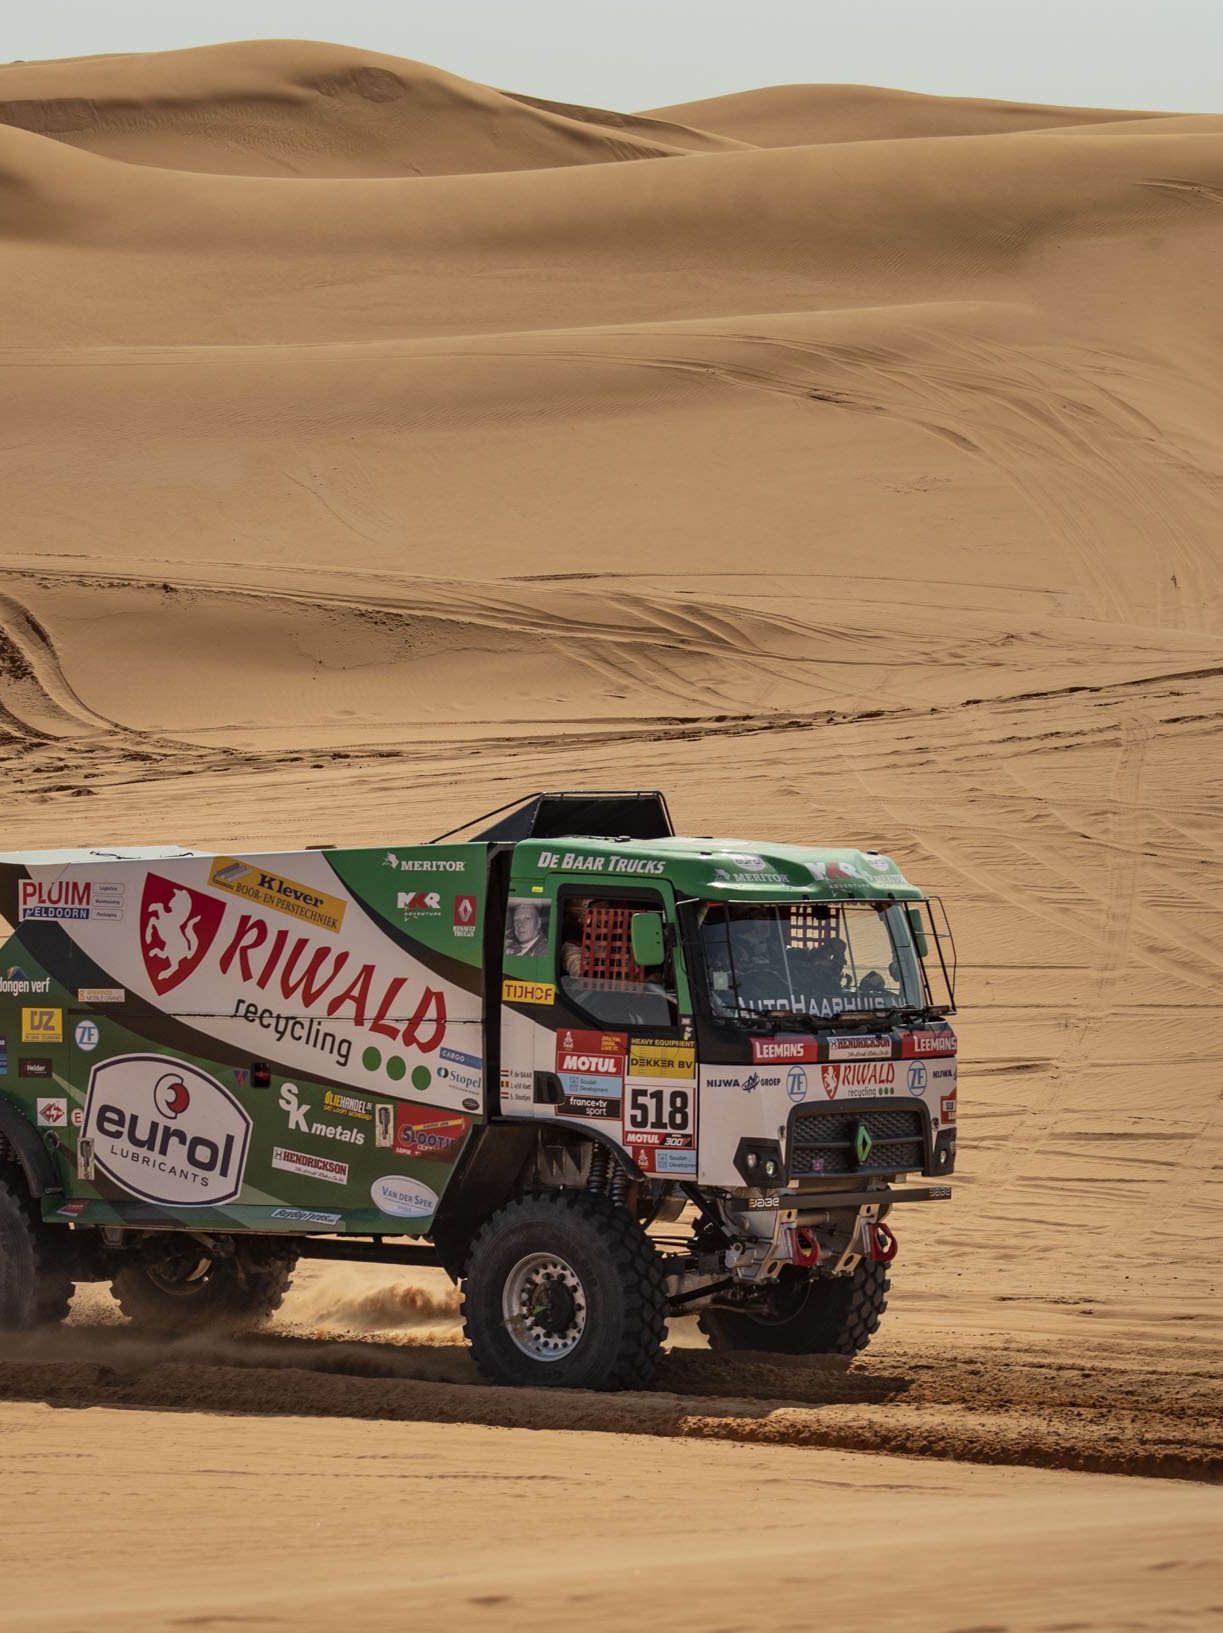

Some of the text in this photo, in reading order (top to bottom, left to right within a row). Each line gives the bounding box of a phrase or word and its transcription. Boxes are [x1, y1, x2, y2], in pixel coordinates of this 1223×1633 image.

[401, 861, 465, 871] MERITOR
[561, 853, 605, 870] BAAR
[608, 856, 666, 874] TRUCKS
[734, 873, 790, 883] MERITOR
[23, 881, 91, 905] PLUIM
[258, 873, 324, 908] Klever
[276, 898, 338, 929] PERSTECHNIEK
[31, 977, 51, 992] verf
[219, 915, 447, 1053] RIWALD
[504, 984, 553, 1000] TIJHOF
[77, 1026, 97, 1045] ZF
[234, 999, 353, 1067] recycling
[655, 1040, 695, 1048] EQUIPMENT
[756, 1042, 804, 1058] LEEMANS
[914, 1036, 956, 1052] LEEMANS
[563, 1056, 616, 1072] MOTUL
[631, 1058, 674, 1068] DEKKER
[450, 1071, 482, 1088] Stopel
[707, 1079, 740, 1087] NIJWA
[788, 1074, 806, 1094] ZF
[842, 1063, 895, 1086] RIWALD
[909, 1068, 926, 1089] ZF
[848, 1087, 876, 1098] recycling
[586, 1108, 607, 1116] sport
[630, 1089, 688, 1130] 518
[96, 1104, 235, 1178] eurol
[311, 1122, 365, 1144] metals
[627, 1134, 659, 1144] MOTUL
[111, 1144, 209, 1186] LUBRICANTS
[283, 1151, 347, 1176] HENDRICKSON
